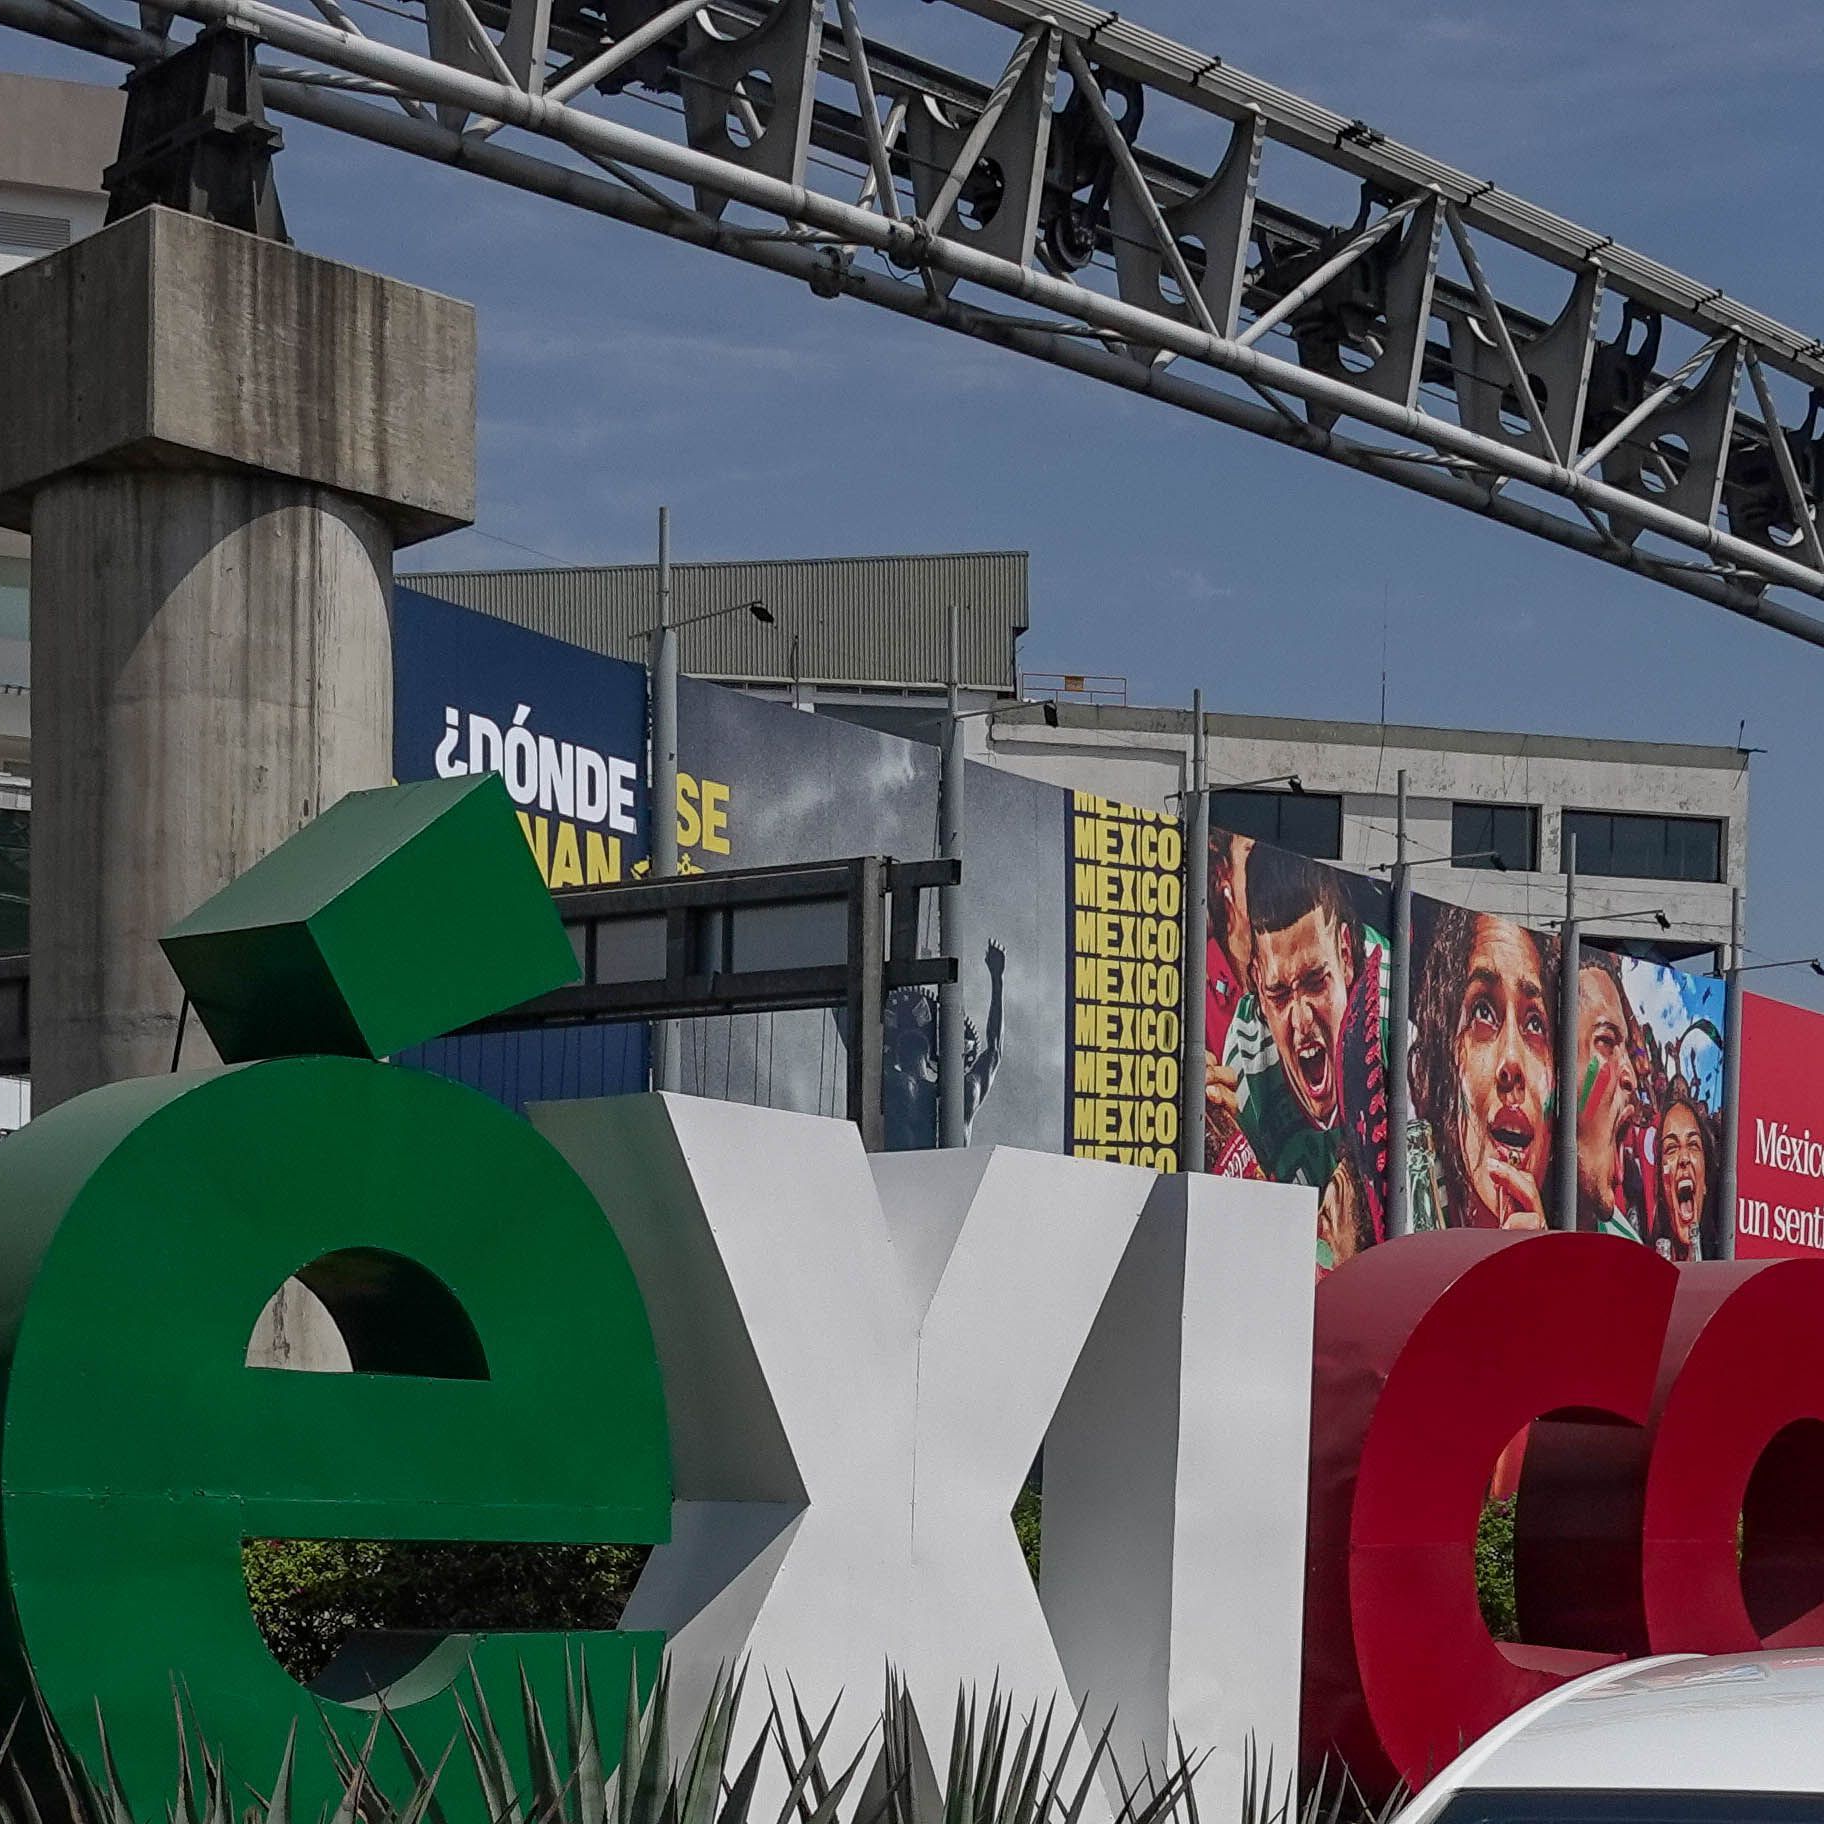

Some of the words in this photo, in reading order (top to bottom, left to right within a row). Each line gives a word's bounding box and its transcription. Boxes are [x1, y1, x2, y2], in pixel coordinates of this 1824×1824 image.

[434, 703, 638, 836] ¿DÓNDE
[677, 772, 731, 856] SE
[1738, 1198, 1770, 1239] un
